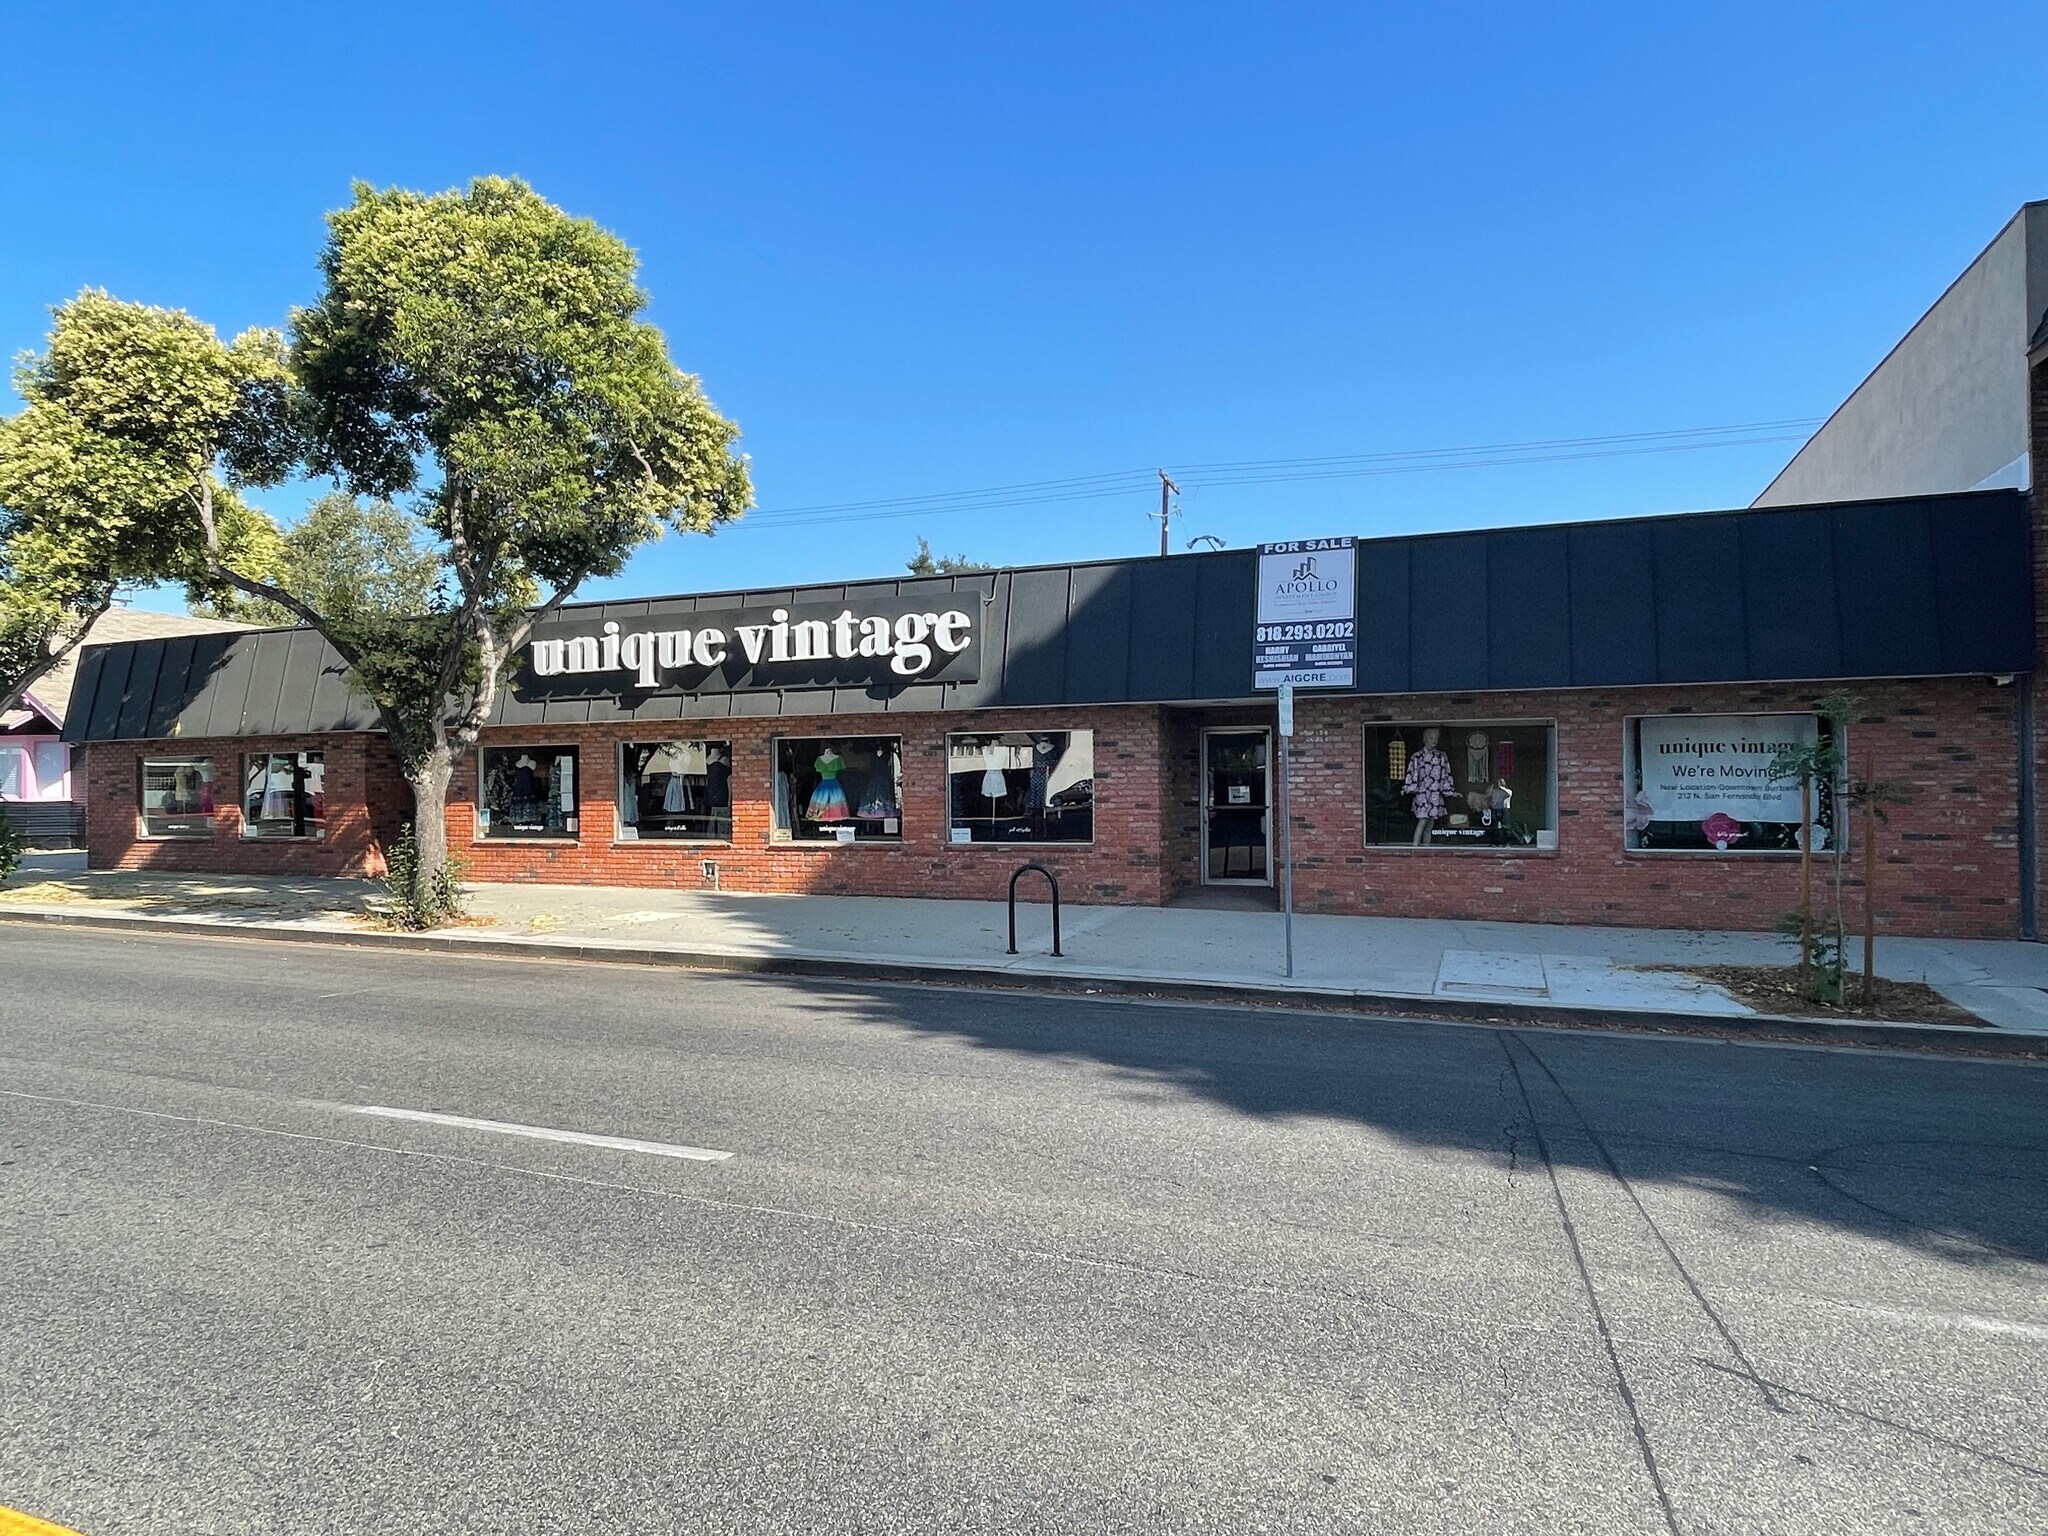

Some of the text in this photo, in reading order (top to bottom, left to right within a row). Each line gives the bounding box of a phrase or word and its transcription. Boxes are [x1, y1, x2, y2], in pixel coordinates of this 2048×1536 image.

[1264, 537, 1353, 554] FOR SALE
[1275, 579, 1338, 594] APOLLO
[1256, 621, 1354, 643] 818.293.0202
[530, 608, 973, 688] unique vintage
[1660, 737, 1725, 758] unique
[1672, 765, 1715, 778] We're
[1722, 792, 1760, 800] Fernando
[1763, 793, 1782, 801] Blvd
